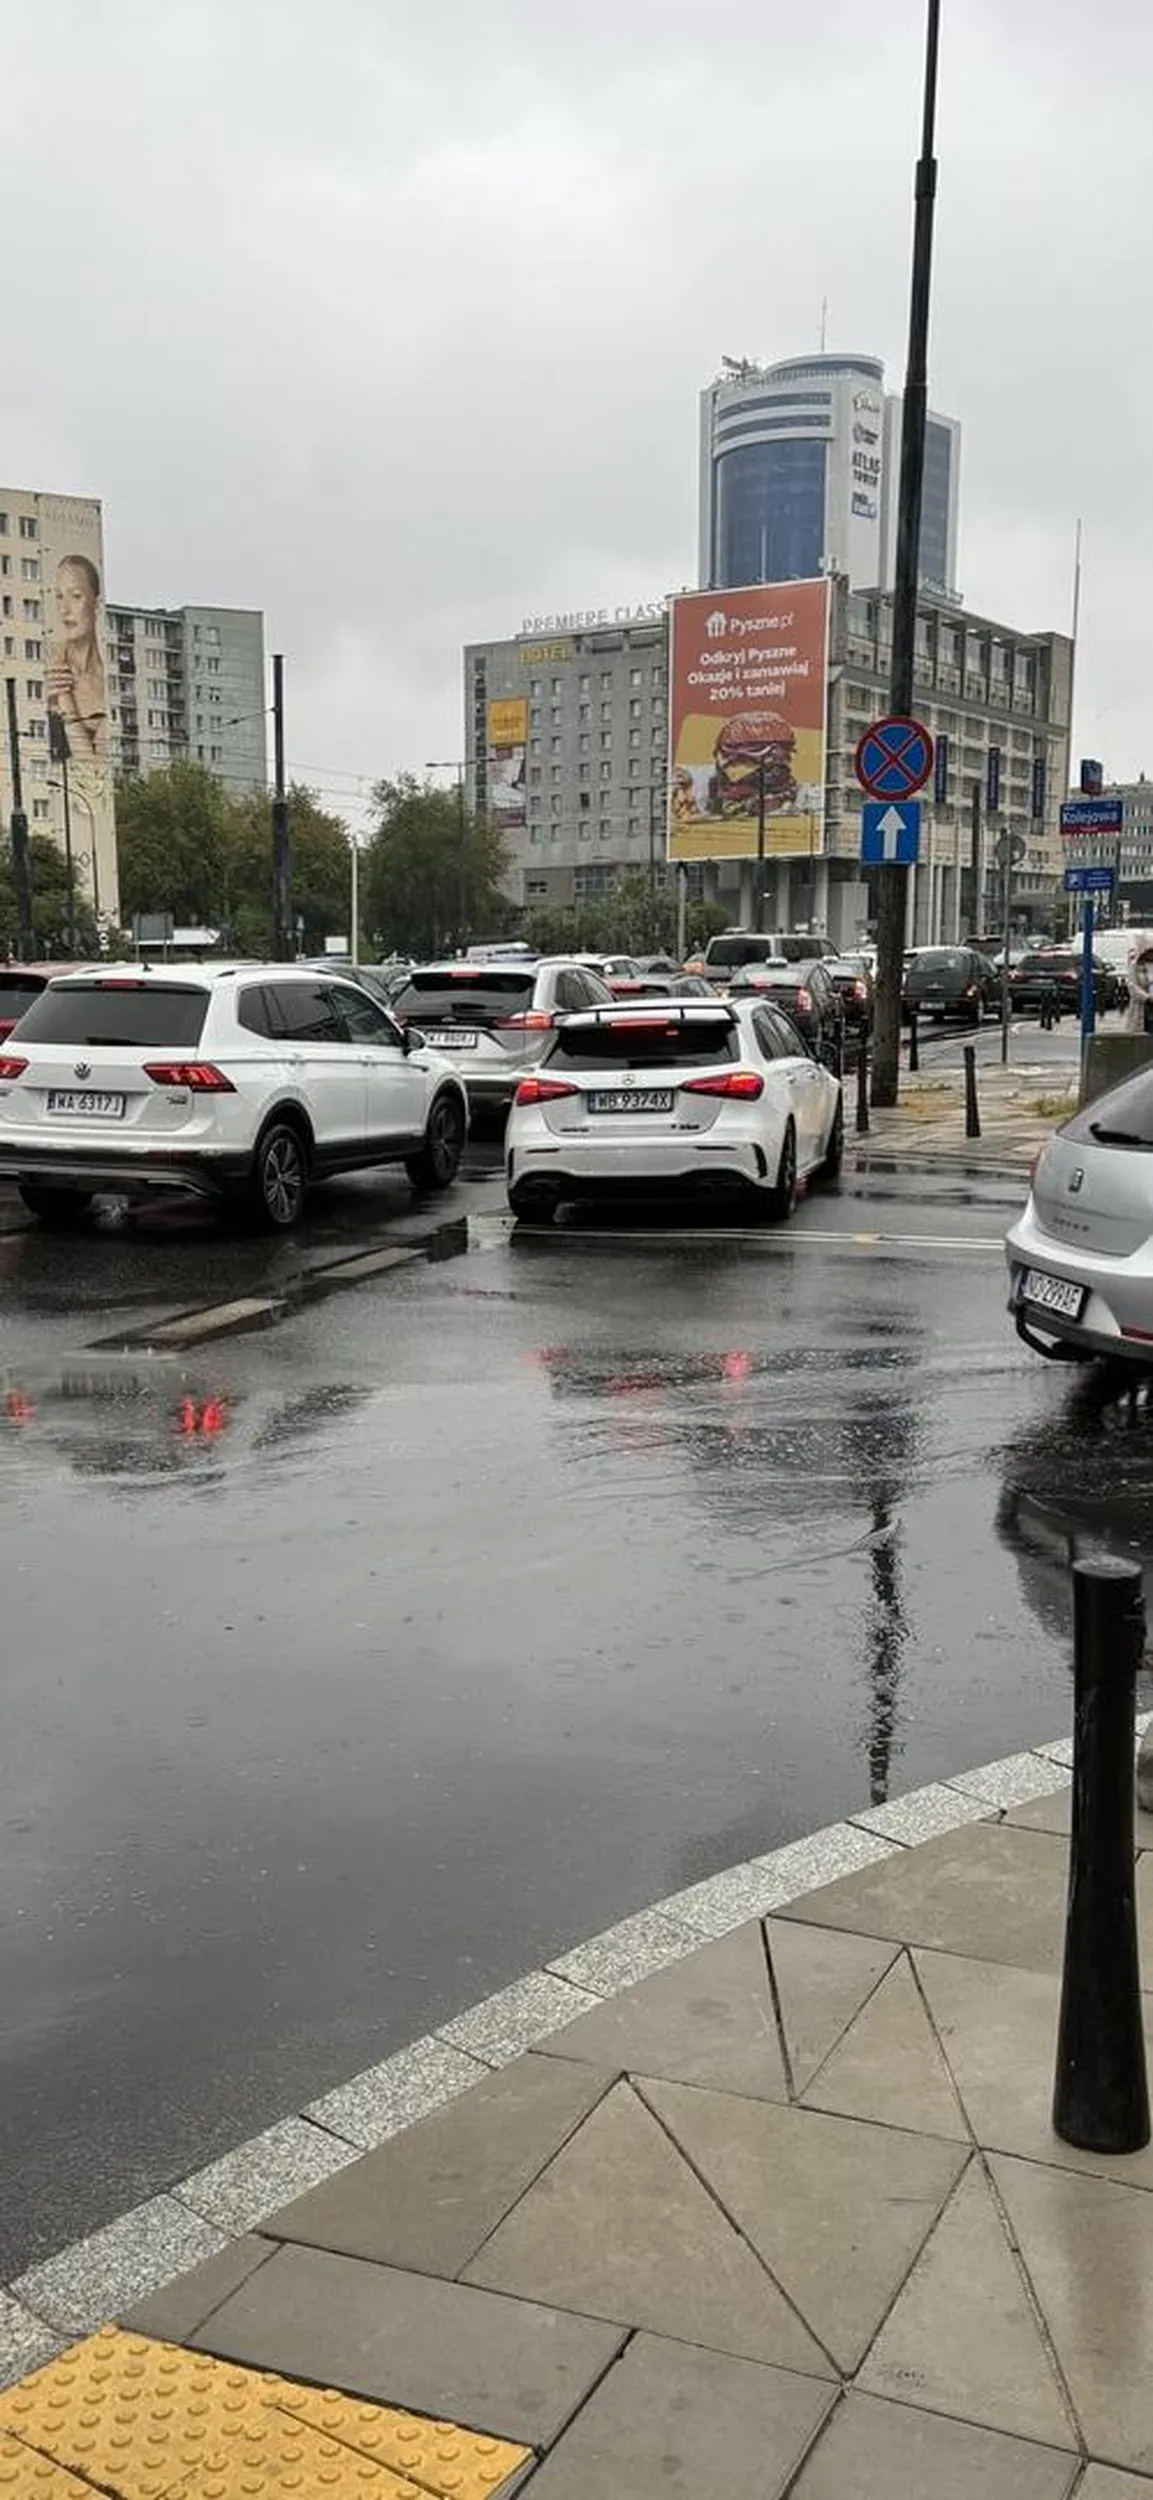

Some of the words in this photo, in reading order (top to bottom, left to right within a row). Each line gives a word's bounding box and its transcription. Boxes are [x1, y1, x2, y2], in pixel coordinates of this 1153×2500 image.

[852, 451, 880, 474] ATLAS
[522, 607, 608, 633] PREMIERE
[730, 611, 794, 635] Pyszne.pl
[519, 641, 567, 666] HOTEL
[700, 648, 746, 666] Odkryj
[748, 646, 797, 663] Pyszne
[687, 669, 733, 685] Okazje
[742, 659, 809, 679] zamawiaj
[710, 686, 743, 701] 20%
[745, 679, 786, 698] taniej
[1062, 807, 1118, 825] Kolejowa
[621, 1088, 669, 1108] 9374X
